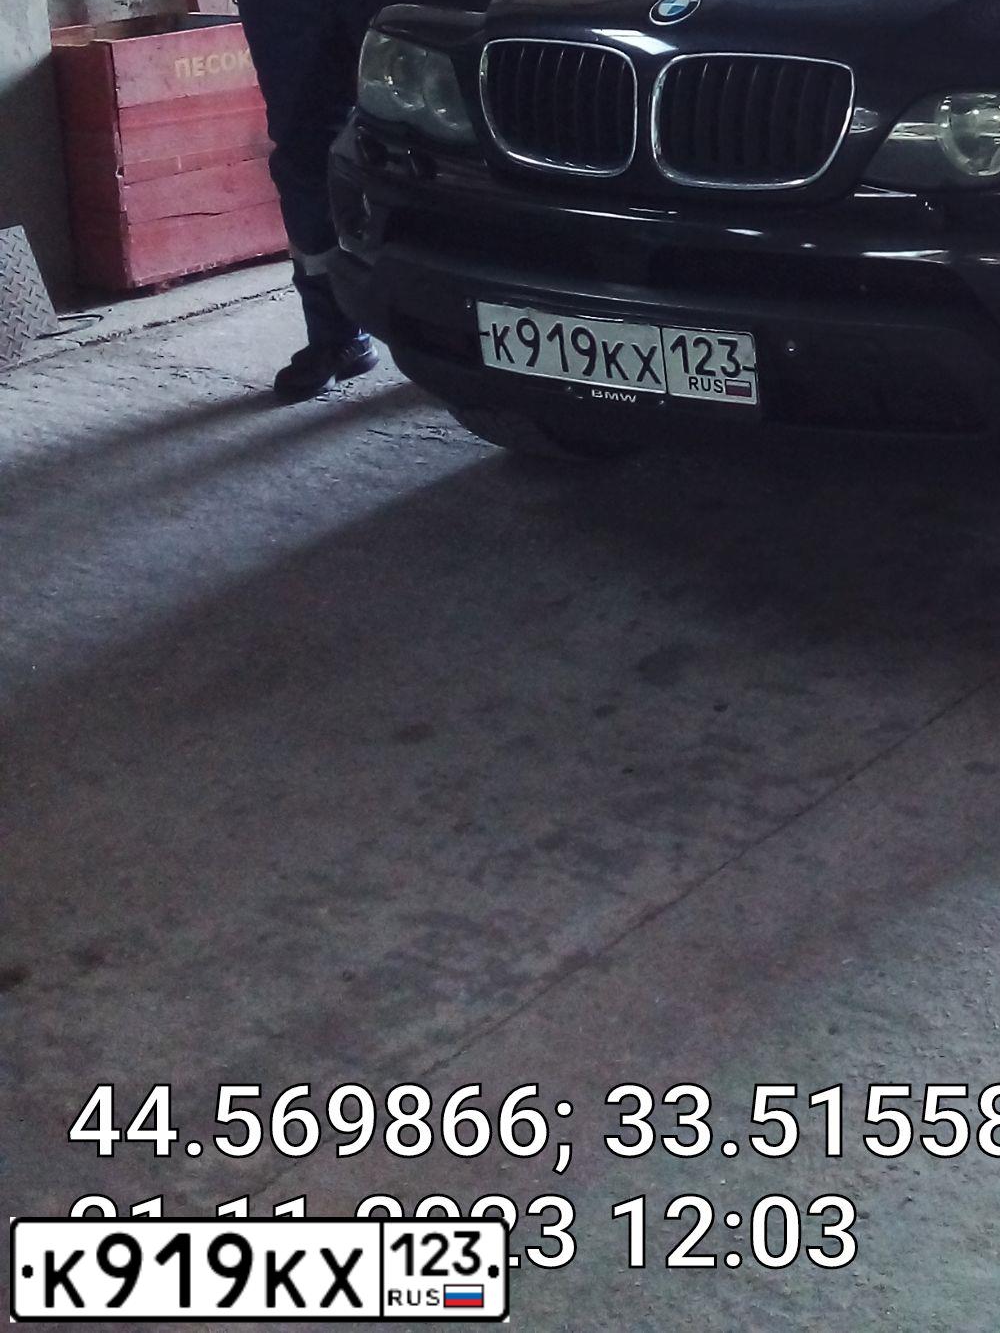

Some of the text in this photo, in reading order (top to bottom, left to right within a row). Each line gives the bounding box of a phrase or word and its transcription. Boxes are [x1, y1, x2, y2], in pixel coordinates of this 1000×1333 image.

[174, 48, 252, 79] ПЕСОК
[669, 334, 742, 379] 123
[591, 389, 637, 403] BMW
[688, 376, 724, 394] RUS
